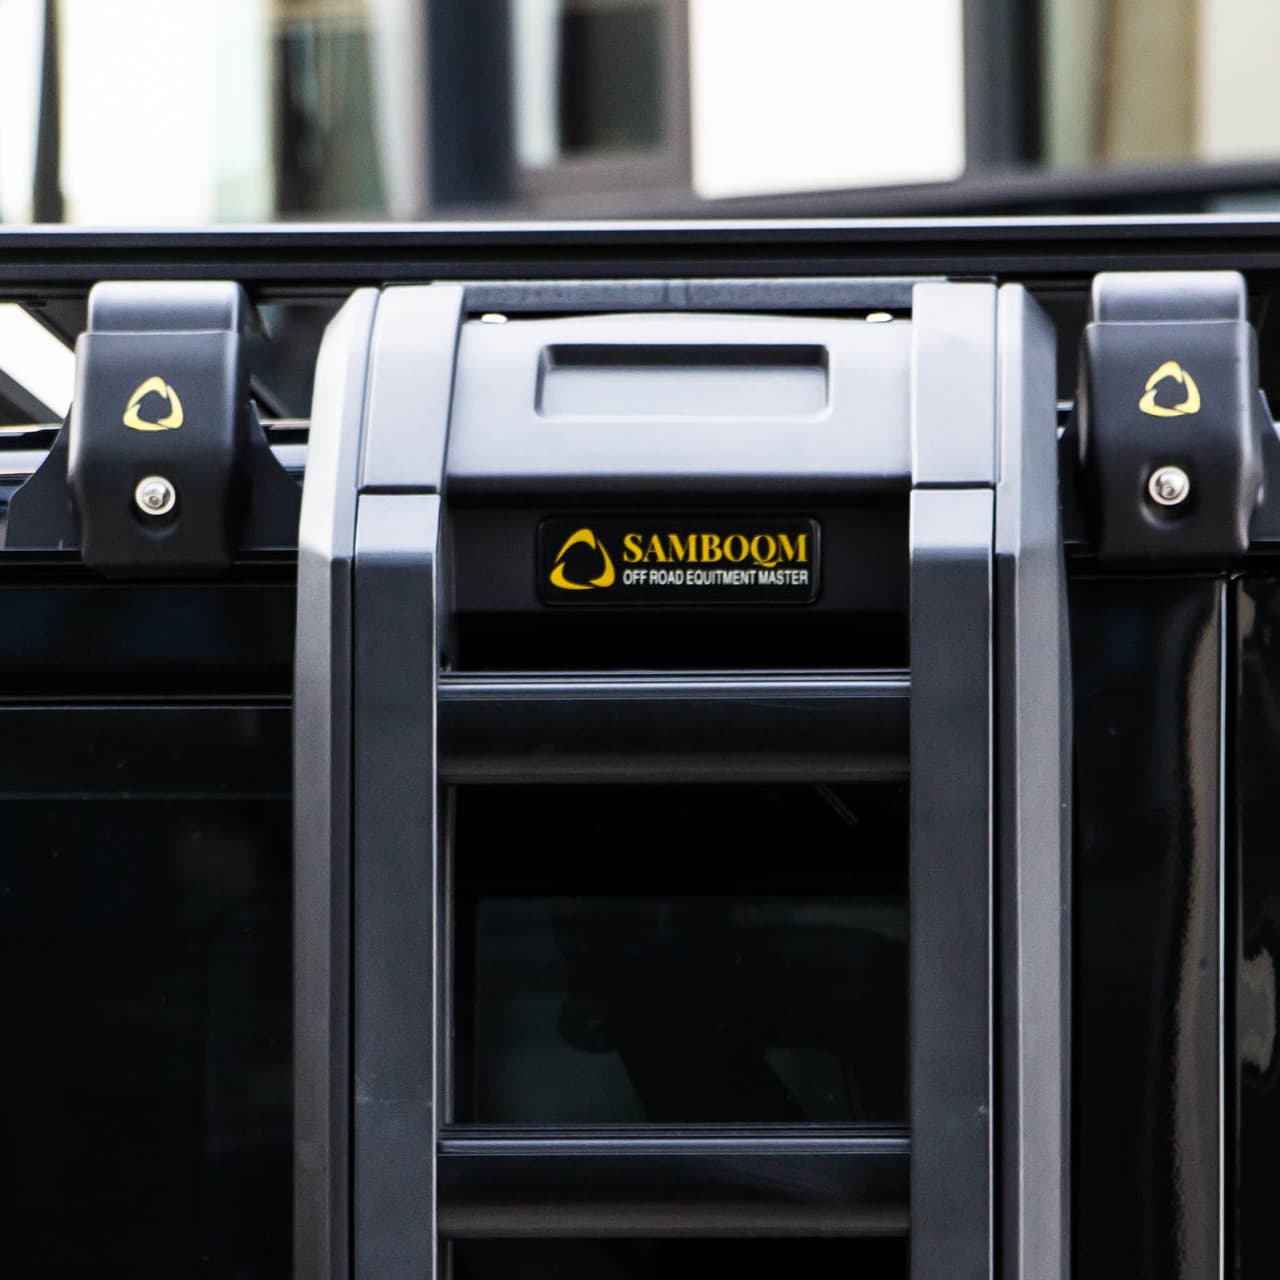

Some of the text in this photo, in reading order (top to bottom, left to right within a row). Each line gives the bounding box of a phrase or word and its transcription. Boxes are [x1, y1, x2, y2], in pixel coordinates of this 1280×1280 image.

[623, 533, 808, 568] SAMBOQM
[623, 569, 809, 585] OFF ROAD EQUITMENT MASTER
